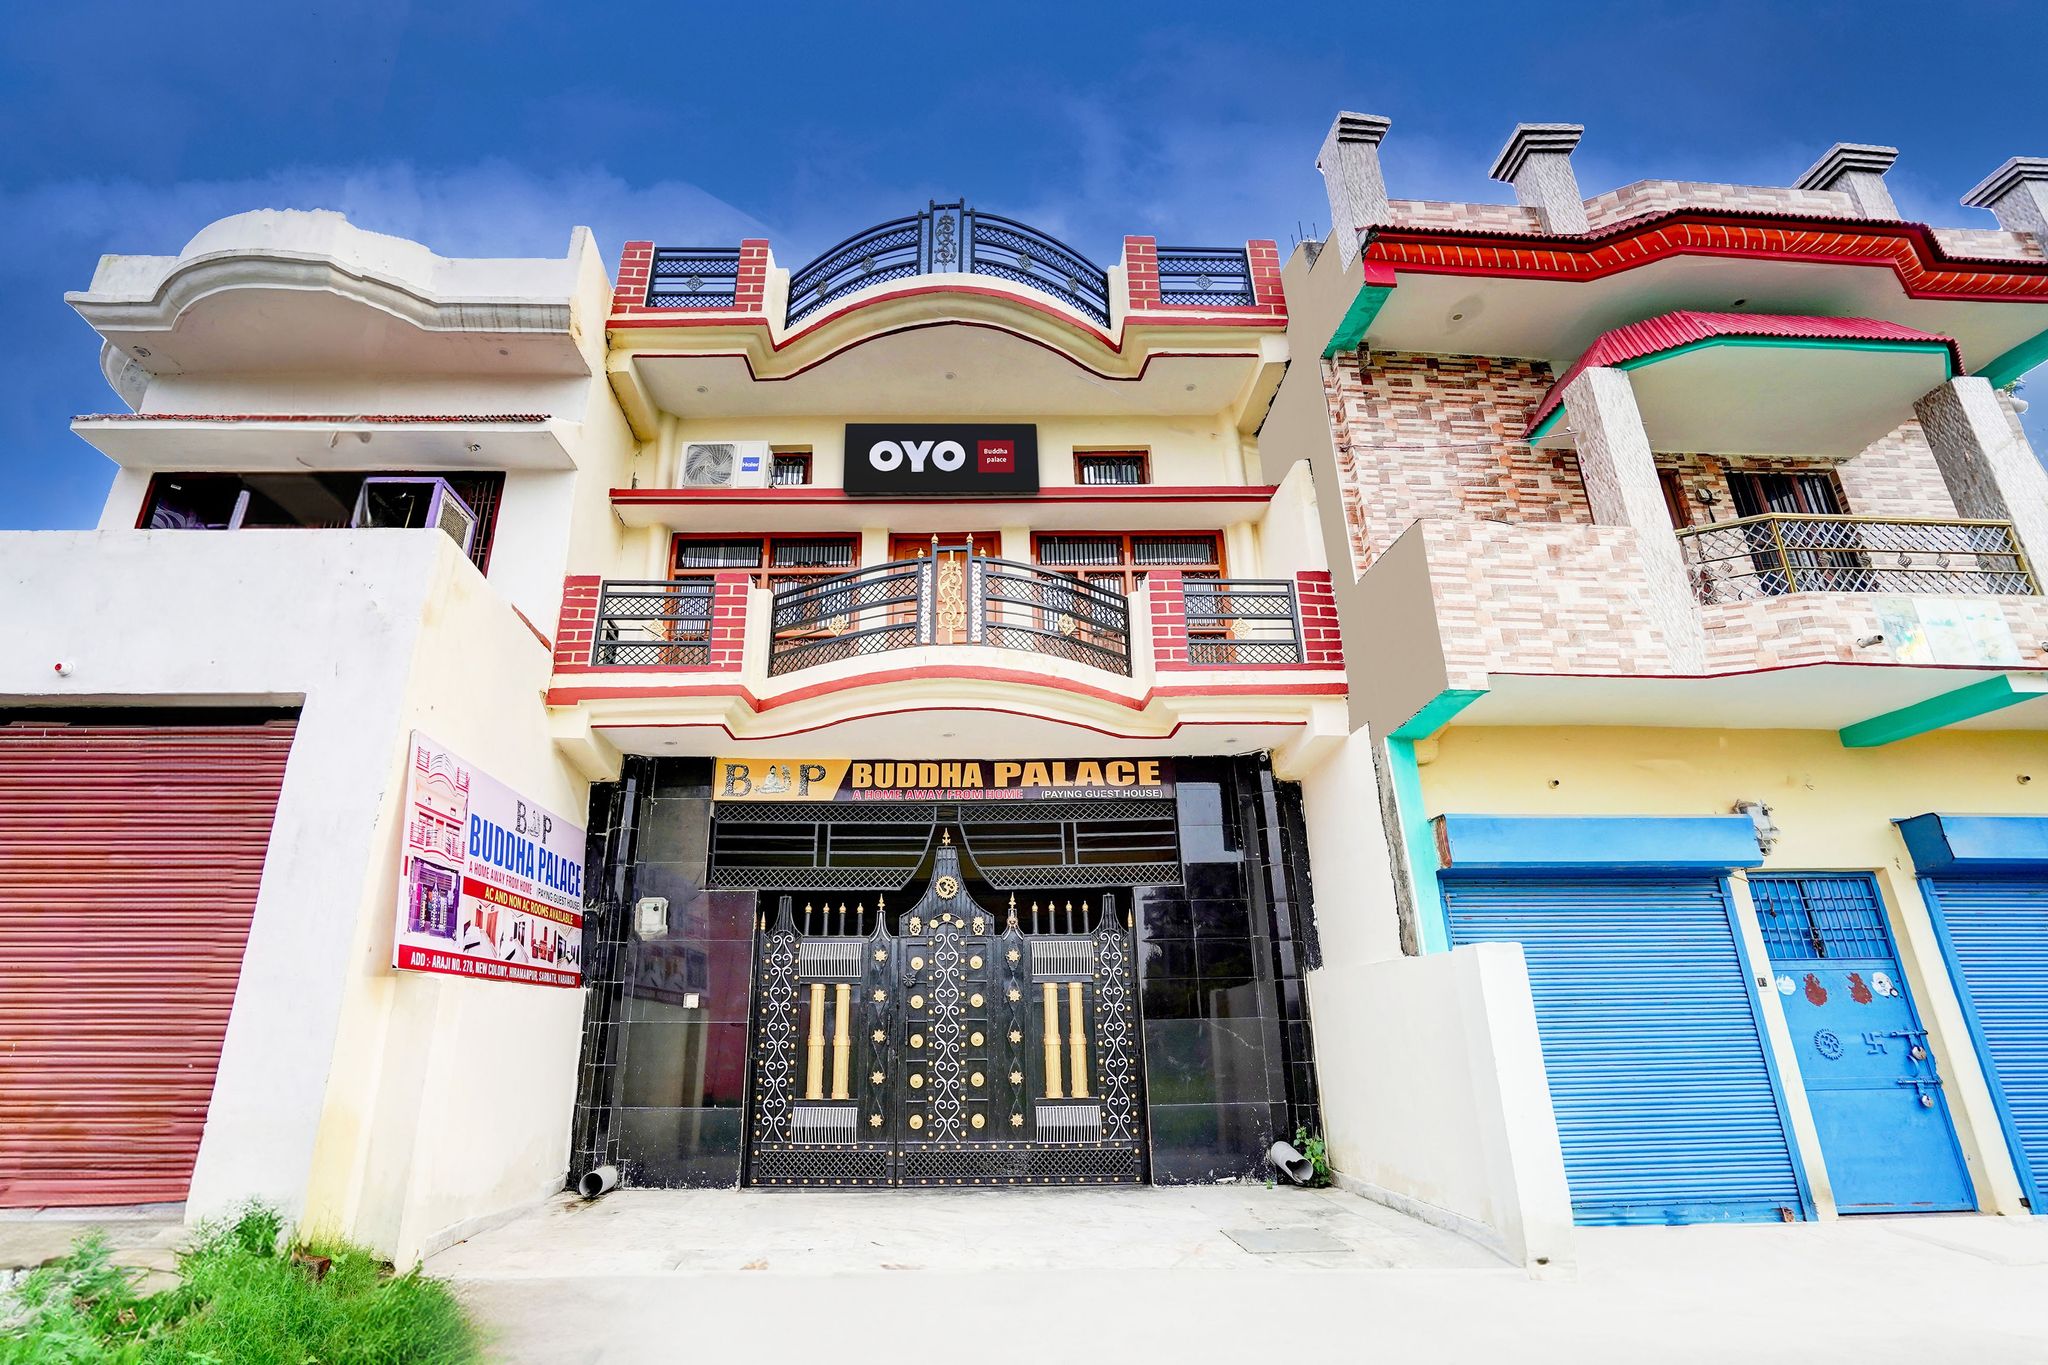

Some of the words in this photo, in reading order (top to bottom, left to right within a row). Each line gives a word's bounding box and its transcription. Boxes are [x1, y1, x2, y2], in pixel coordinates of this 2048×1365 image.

[869, 440, 966, 472] OYO
[721, 764, 752, 797] B
[798, 764, 826, 797] P
[852, 762, 984, 788] BUDDHA
[994, 760, 1162, 788] PALACE
[852, 789, 861, 800] A
[864, 789, 902, 800] HOME
[905, 789, 947, 800] AWAY
[948, 789, 983, 800] FROM
[986, 789, 1024, 799] HOME
[1041, 789, 1083, 799] (PAYING
[1084, 789, 1120, 798] GUEST
[1123, 788, 1163, 798] HOUSE)
[515, 800, 527, 834] B
[541, 815, 552, 844] P
[469, 813, 534, 880] BUDDHA
[538, 846, 581, 898] PALACE
[469, 860, 473, 873] A
[474, 863, 489, 879] HOME
[490, 869, 505, 884] AWAY
[506, 874, 519, 889] FROM
[485, 886, 495, 900] AC
[495, 890, 507, 905] AND
[508, 894, 521, 910] NON
[522, 902, 530, 912] AC
[531, 904, 549, 917] ROOMS
[549, 908, 573, 925] AVAILABLE
[411, 951, 425, 966] ADD
[432, 955, 451, 970] ARAJI
[451, 958, 461, 971] NO.
[475, 961, 487, 974] NEW
